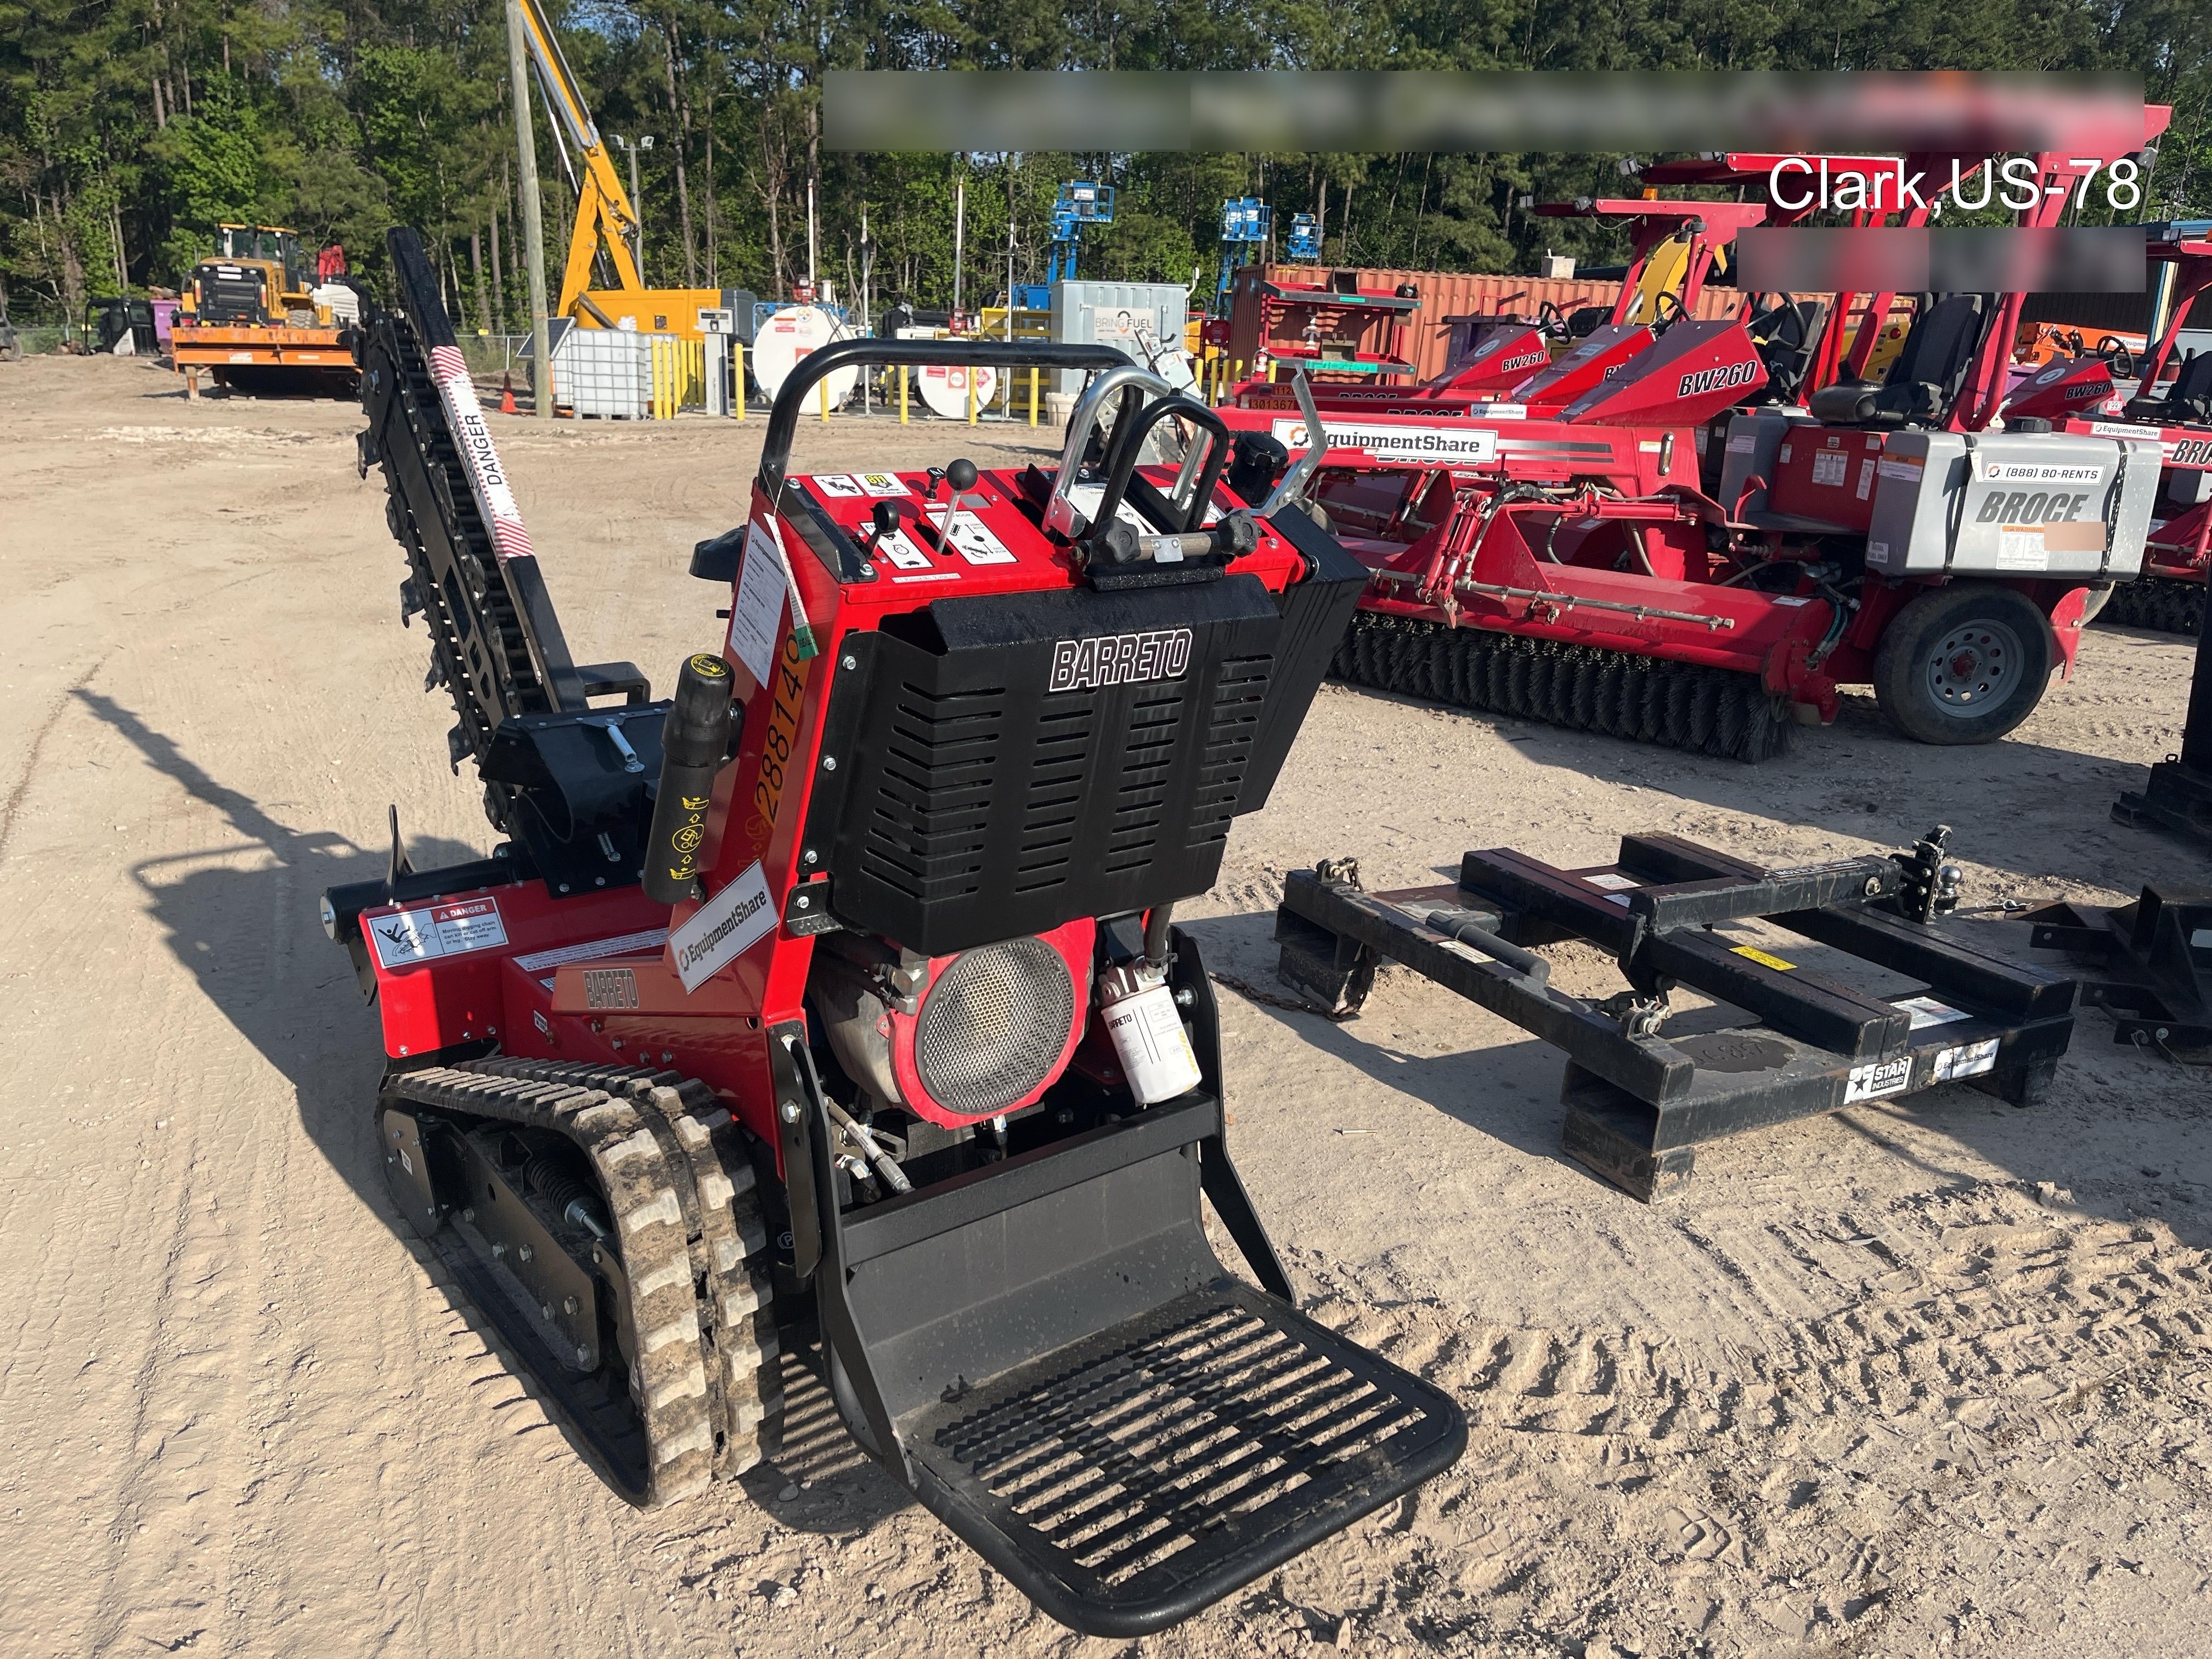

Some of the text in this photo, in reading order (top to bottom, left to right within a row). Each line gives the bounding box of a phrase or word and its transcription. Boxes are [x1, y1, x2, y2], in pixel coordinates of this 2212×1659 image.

[1096, 318, 1153, 329] BRING FUEL
[1502, 350, 1545, 373] BW260
[1677, 359, 1757, 398] BW260
[1276, 386, 1295, 395] 112
[2064, 382, 2112, 400] BW260
[1251, 399, 1294, 410] 301367
[2102, 425, 2159, 437] EquipmentShare
[464, 415, 503, 485] DANGER
[1323, 431, 1480, 453] quipmentShare
[865, 475, 887, 484] 811
[2006, 467, 2099, 479] (888) 80-RENTS
[1975, 491, 2089, 524] BROCE
[1049, 628, 1193, 692] BARRETO
[449, 904, 487, 918] DANGER
[462, 923, 481, 932] digging
[481, 920, 496, 928] chain
[687, 890, 767, 962] EquipmentShare
[603, 943, 652, 956] CUSTOMER
[583, 968, 639, 1009] BARRETO
[1943, 1051, 1994, 1070] EquipmentShare
[1874, 1060, 1908, 1081] STAR
[1872, 1075, 1904, 1090] INDUSTRIES
